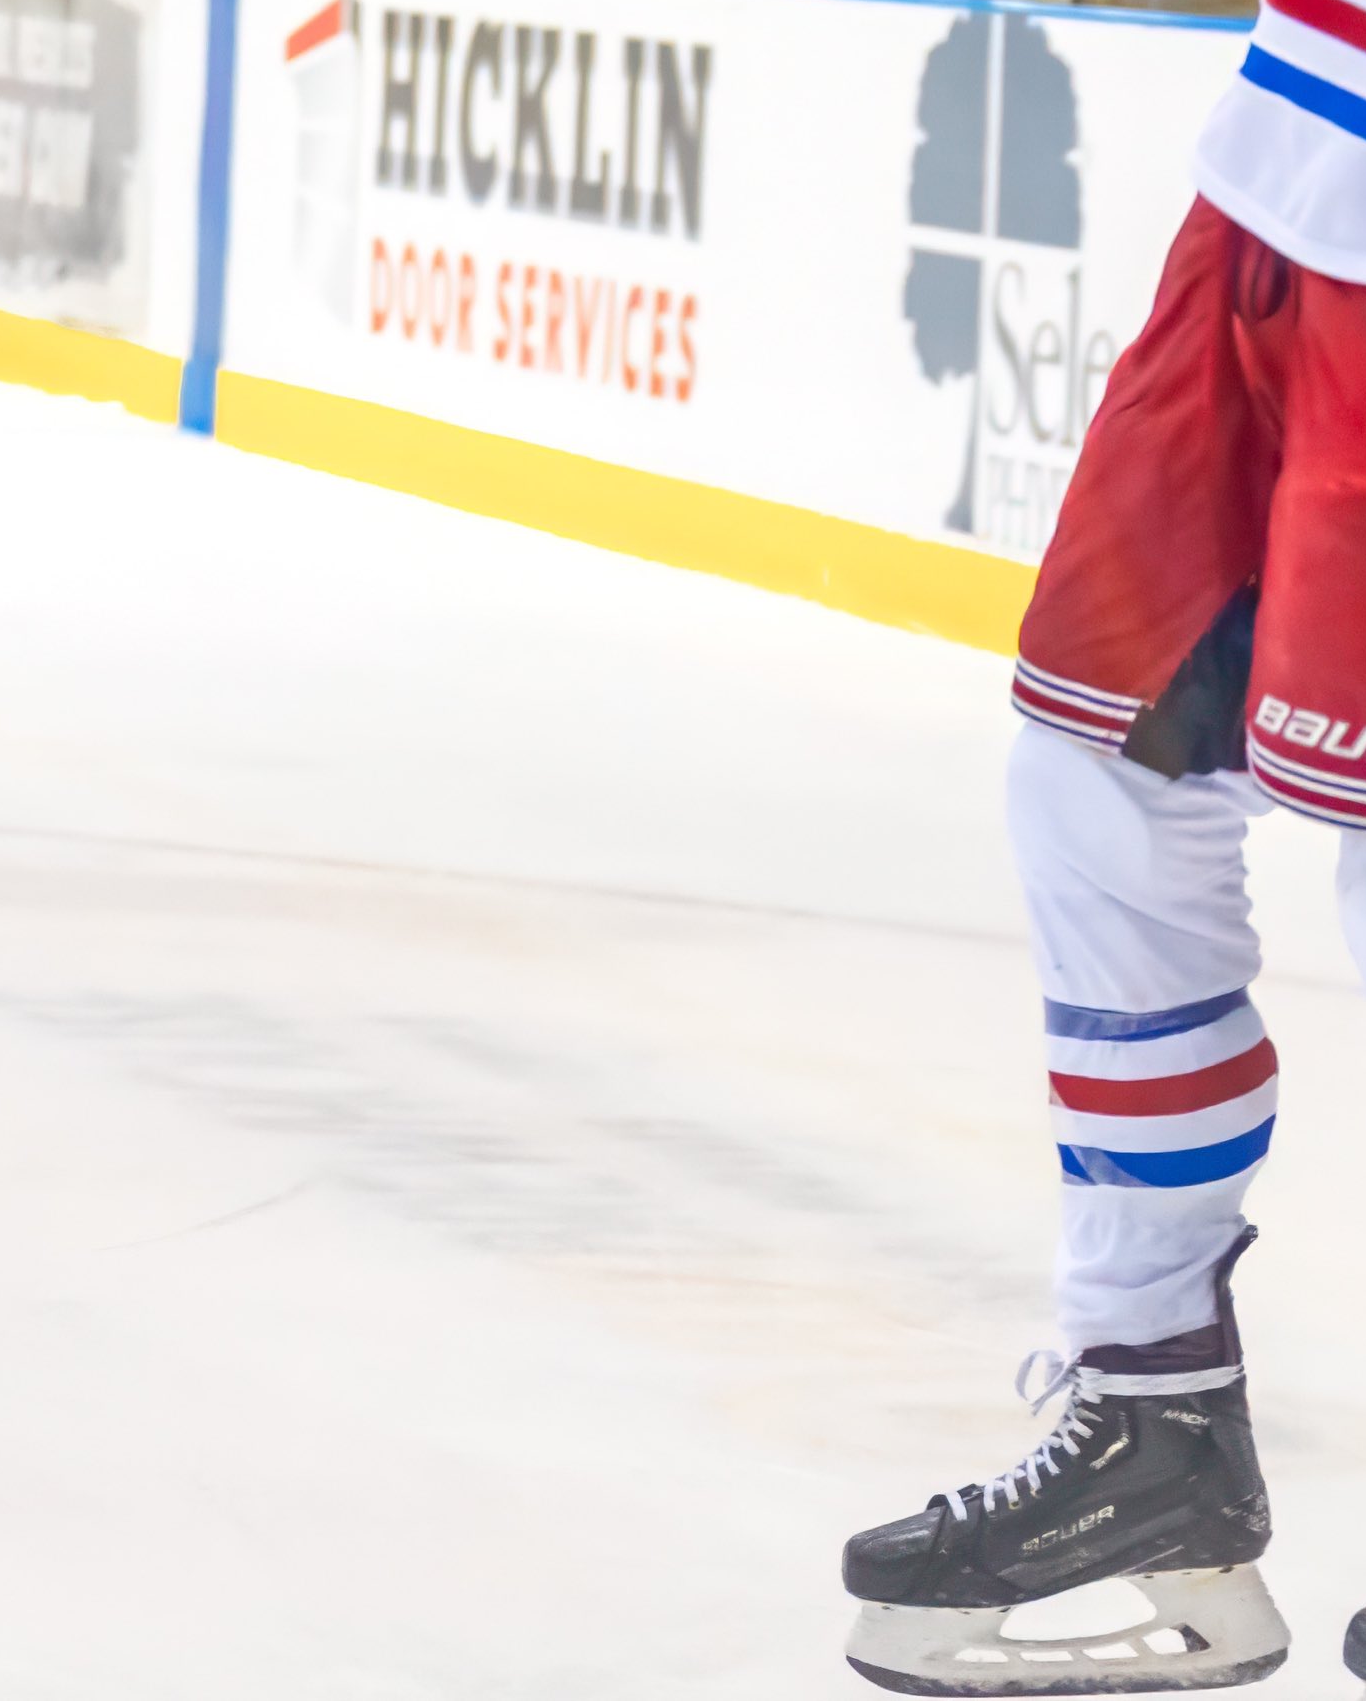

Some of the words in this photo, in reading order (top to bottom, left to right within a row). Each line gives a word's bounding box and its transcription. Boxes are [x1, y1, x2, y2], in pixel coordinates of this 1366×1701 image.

[374, 8, 713, 245] HICKLIN
[369, 235, 478, 356] DOOR
[491, 258, 699, 406] SERVICES
